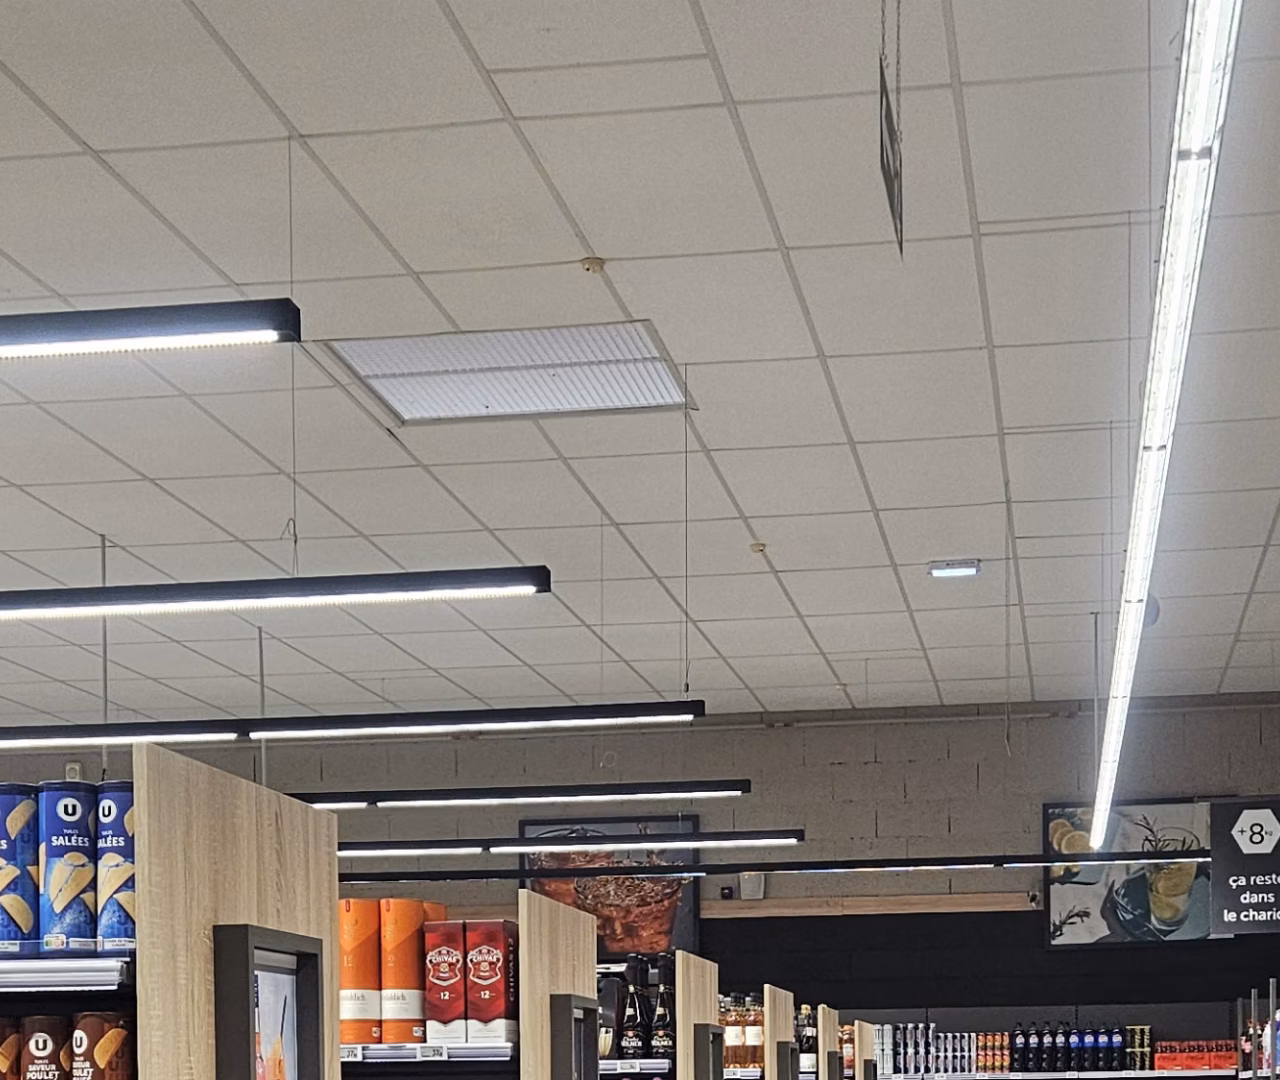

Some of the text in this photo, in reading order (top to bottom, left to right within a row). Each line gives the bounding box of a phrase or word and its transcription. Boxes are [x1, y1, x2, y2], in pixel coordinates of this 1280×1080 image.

[51, 834, 89, 848] SALÉES
[1228, 874, 1247, 889] ça
[1240, 890, 1275, 904] dans
[1223, 908, 1238, 922] le
[431, 953, 459, 964] CHIVAS
[471, 952, 498, 963] CHIVAS
[439, 990, 451, 1000] 12
[479, 990, 491, 1000] 12
